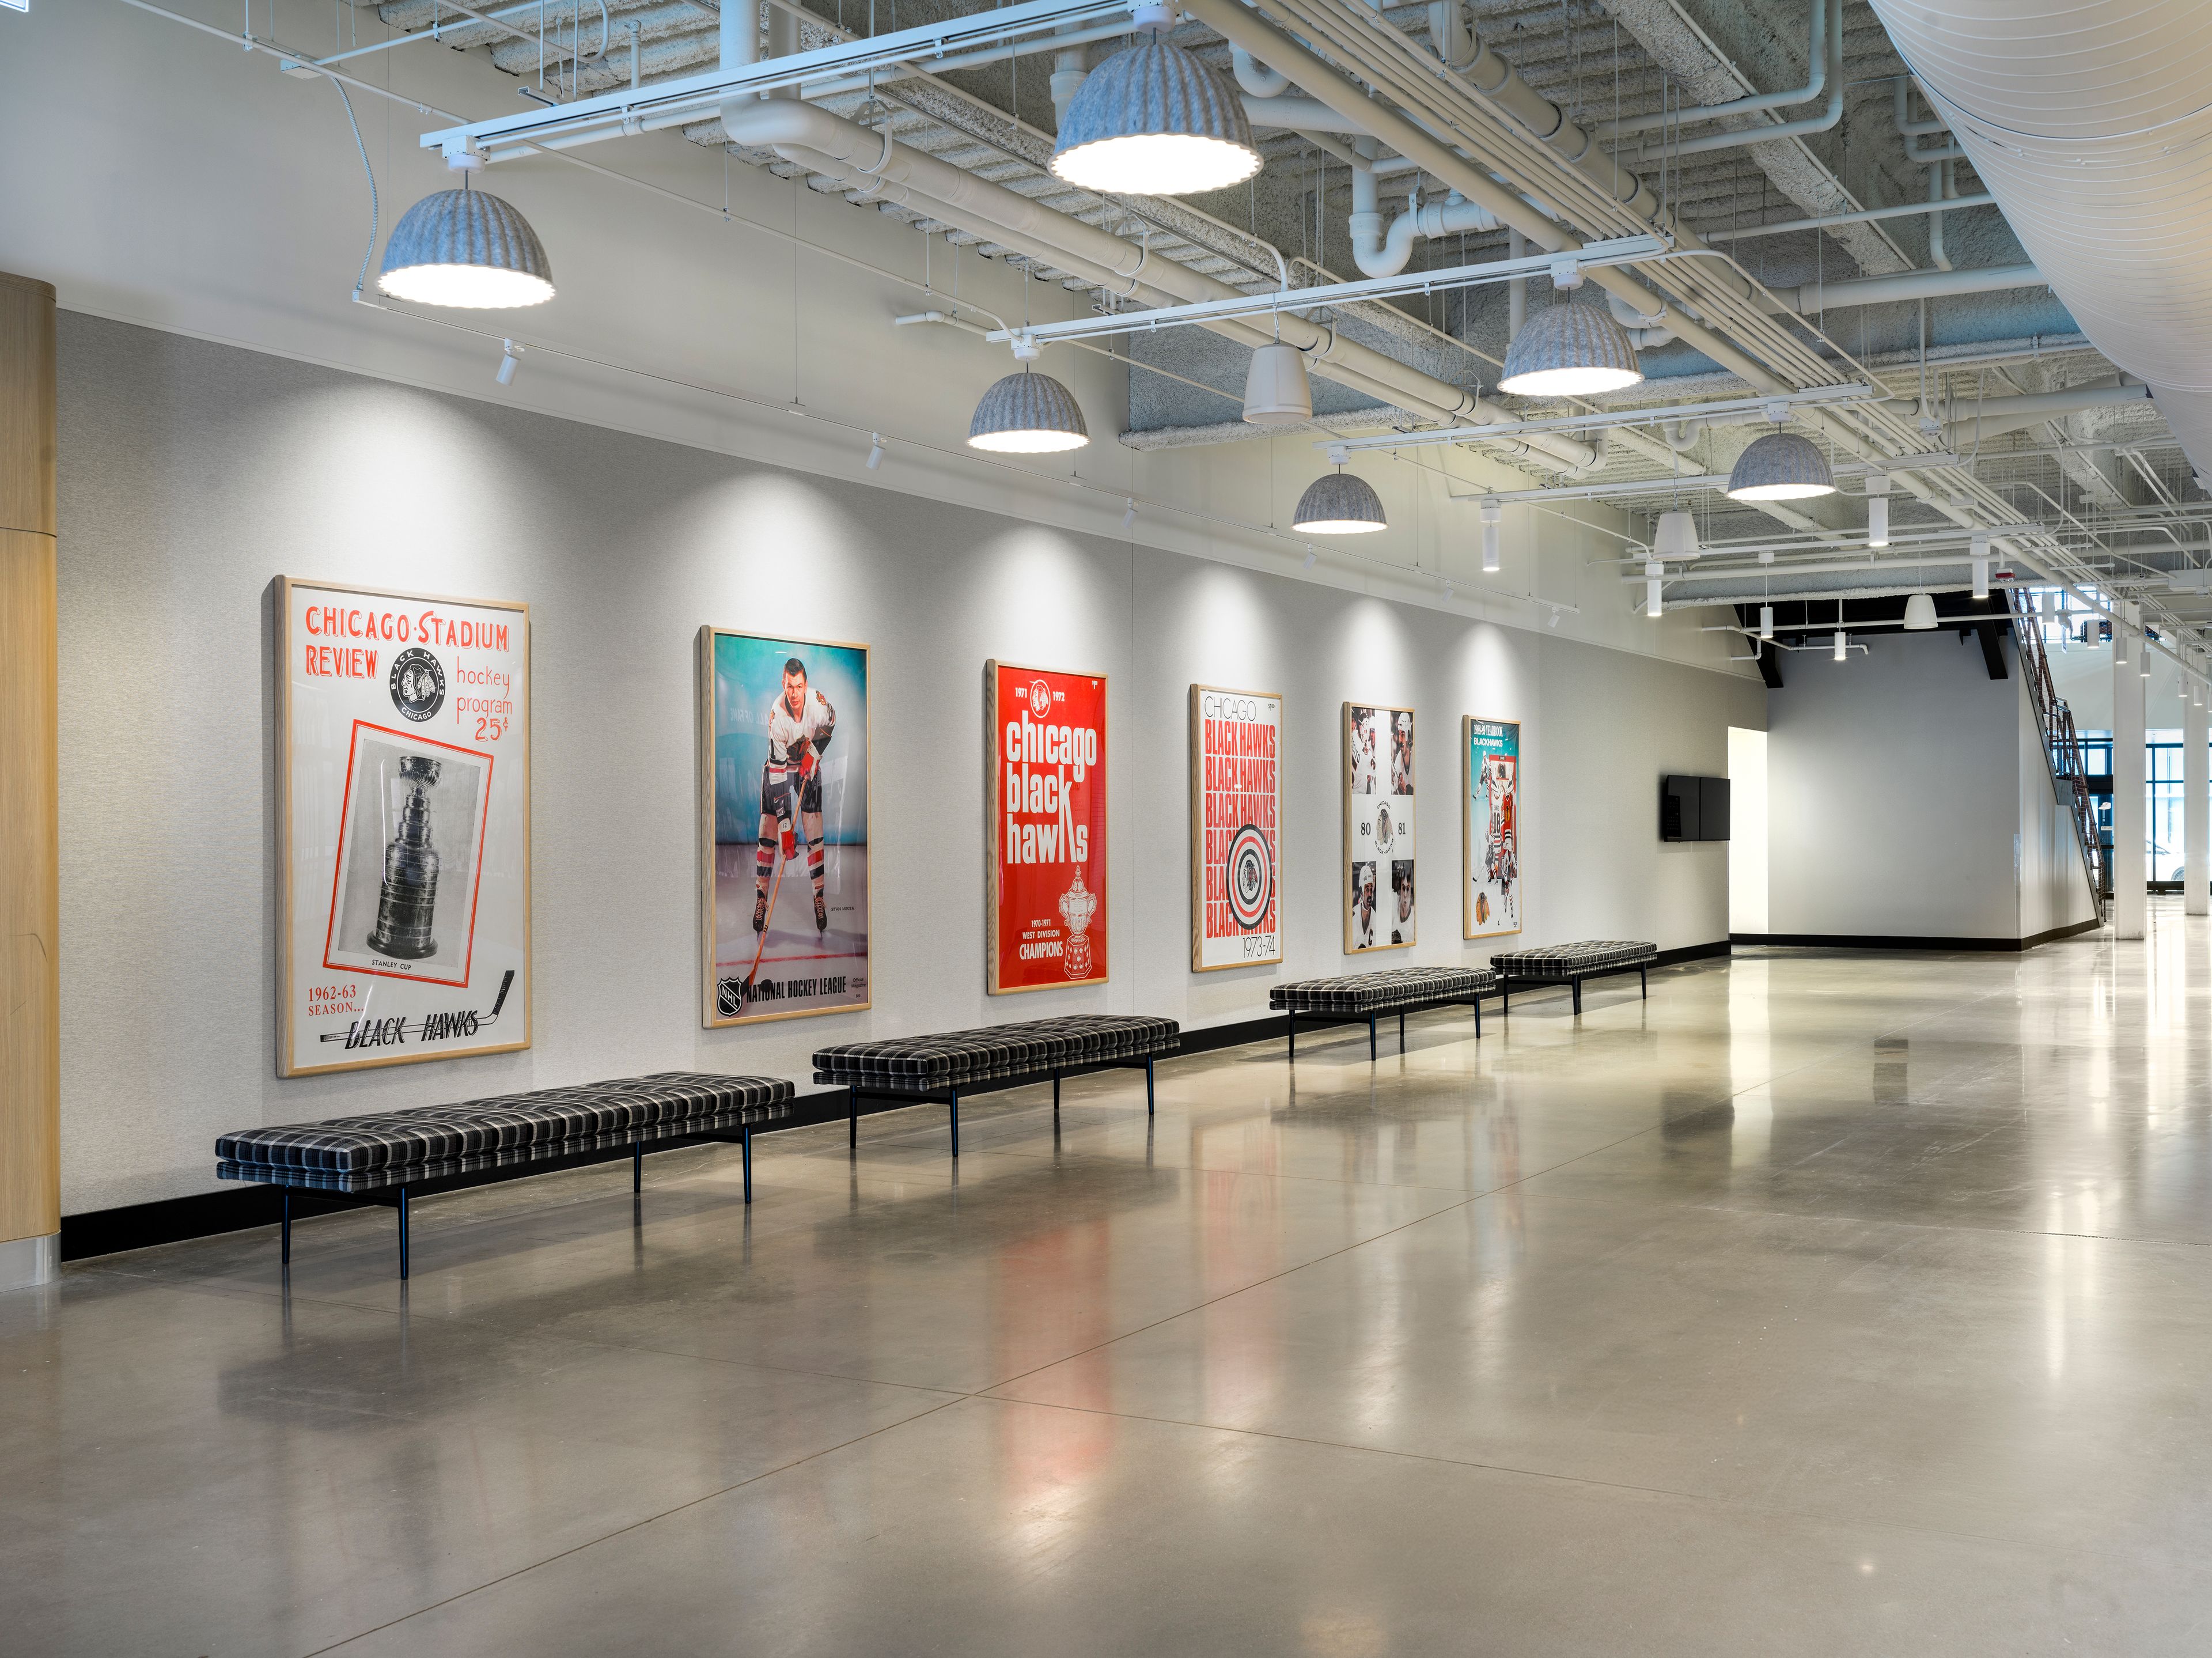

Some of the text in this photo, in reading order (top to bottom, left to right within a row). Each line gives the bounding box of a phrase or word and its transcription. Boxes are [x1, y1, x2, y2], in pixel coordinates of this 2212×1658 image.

[305, 606, 510, 653] CHICAGO STADIUM
[306, 645, 378, 679] REVIEW
[391, 650, 444, 695] BLACK HAWKS
[457, 656, 510, 699] hockey
[1015, 687, 1027, 698] 1971
[1052, 691, 1065, 702] 1972
[402, 707, 431, 720] CHICAGO
[457, 696, 512, 725] program
[1205, 696, 1256, 721] CHICAGO
[1006, 710, 1097, 783] chicago
[1205, 719, 1275, 759] BLACK HAWKS
[1474, 737, 1503, 748] BLACKHAWKS
[1205, 756, 1275, 793] BLACK HAWKS
[1006, 762, 1073, 814] black
[1206, 793, 1275, 828] BLACK HAWKS
[1377, 801, 1391, 809] CHICAGO
[1006, 813, 1088, 864] hawks
[1361, 822, 1371, 835] 80
[1398, 822, 1406, 835] 81
[1022, 929, 1060, 940] WEST DIVISION
[1031, 919, 1051, 928] 1970-1971
[1019, 941, 1063, 960] CHAMPIONS
[1243, 934, 1275, 958] 1973-74
[371, 959, 412, 971] STANLEY CUP
[308, 984, 357, 1002] 1962-63
[722, 986, 738, 1008] NHL
[787, 978, 817, 998] HOCKEY
[820, 976, 846, 995] LEAGUE
[344, 1010, 478, 1050] BLACK HAWKS
